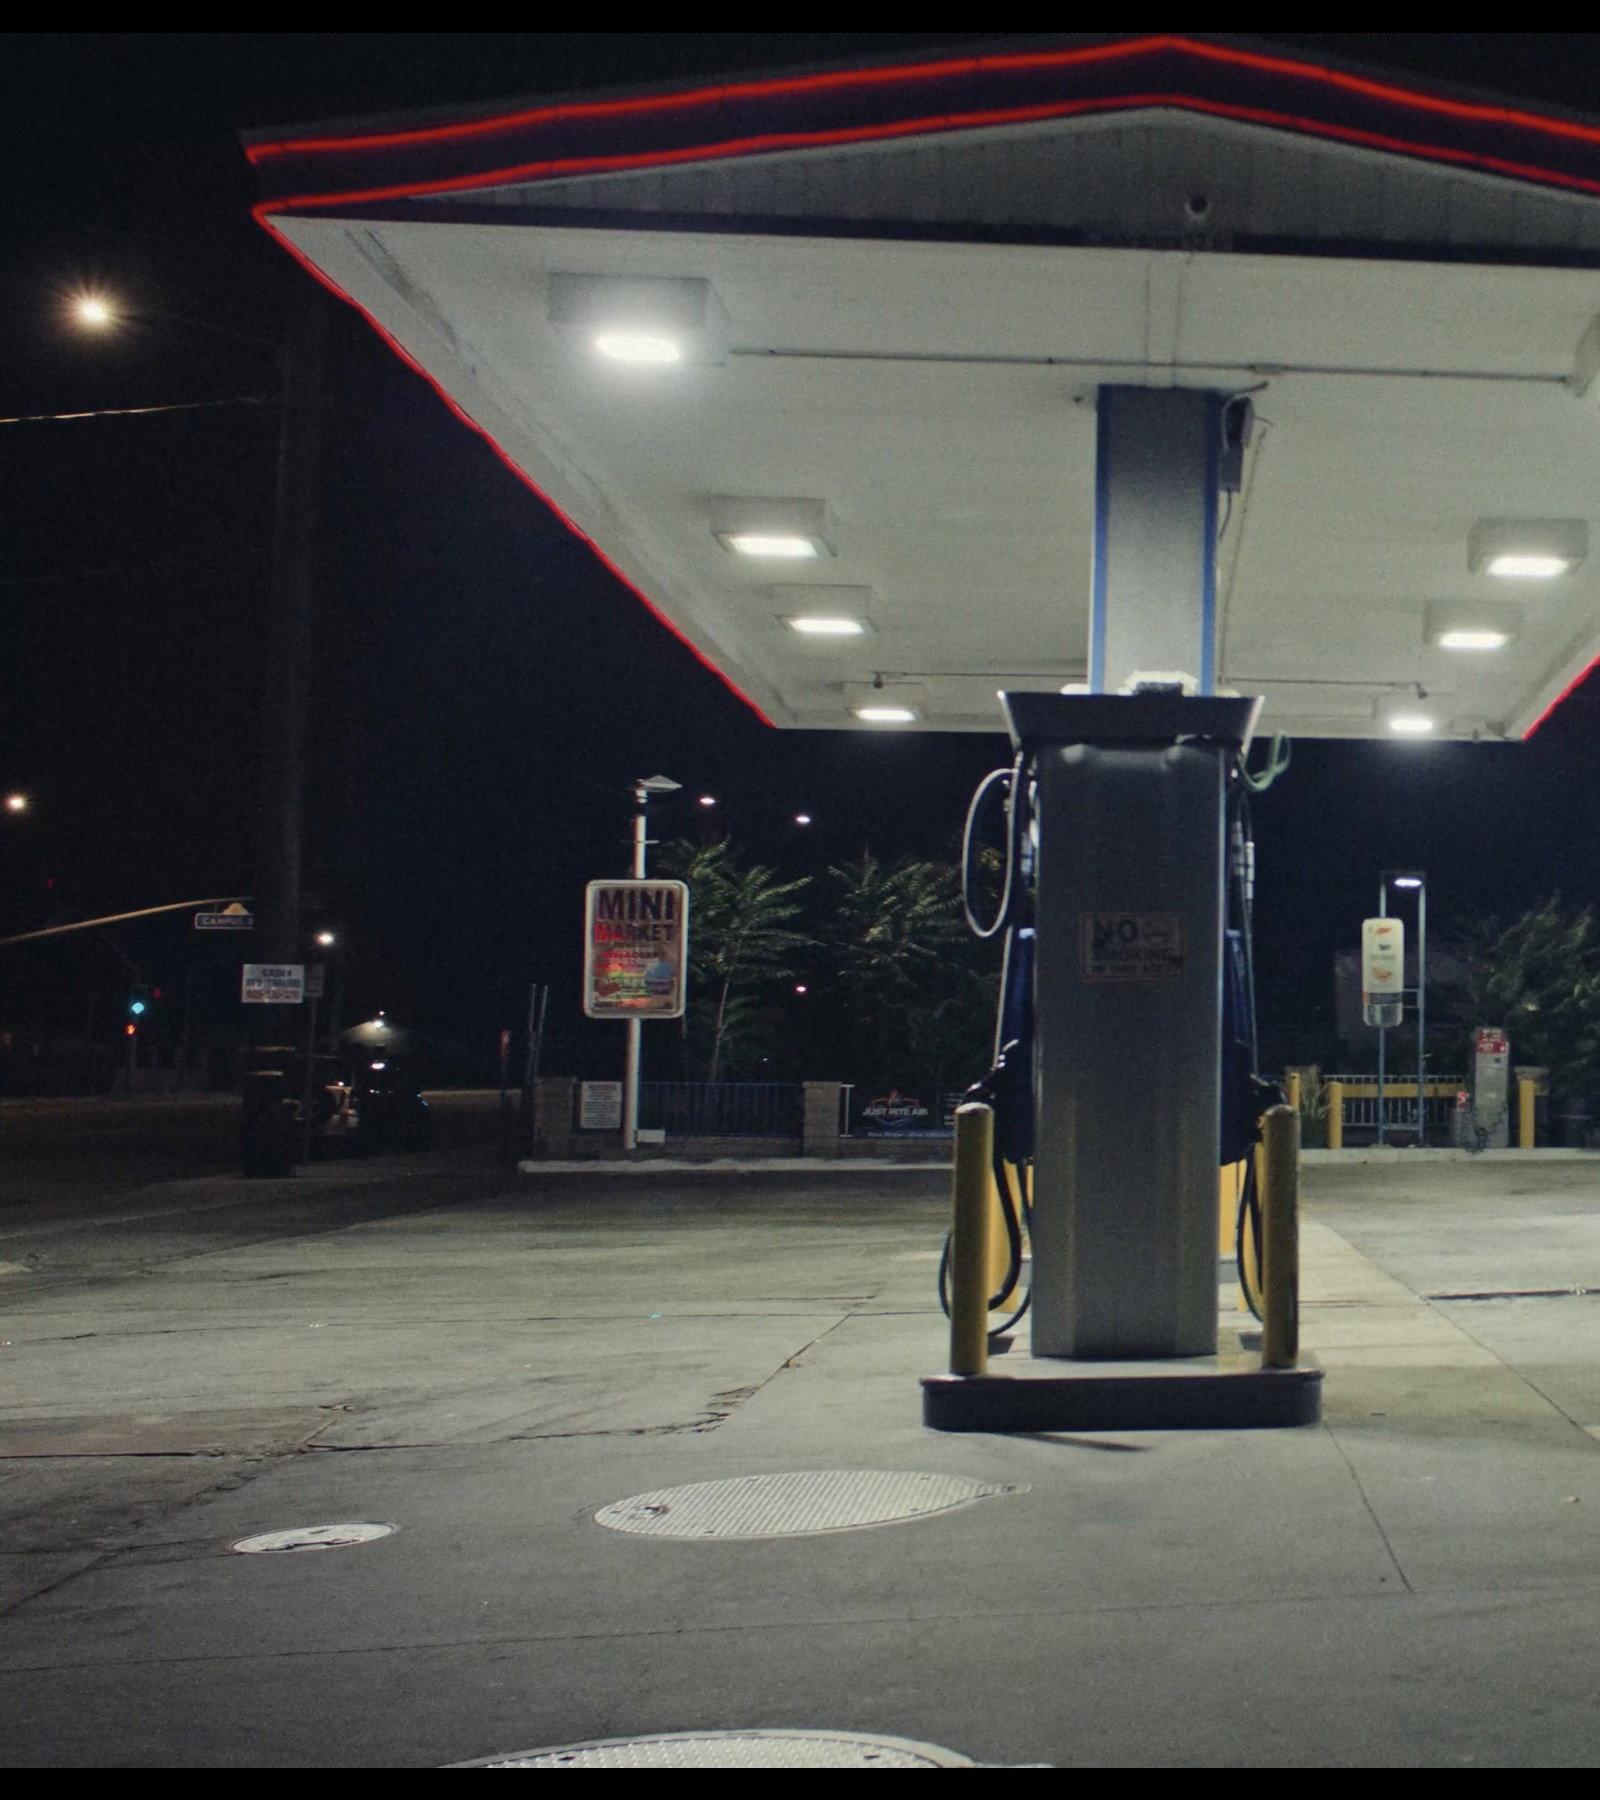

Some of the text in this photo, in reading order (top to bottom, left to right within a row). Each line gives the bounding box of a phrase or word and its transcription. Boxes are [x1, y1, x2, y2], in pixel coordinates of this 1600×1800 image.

[598, 889, 674, 920] MINI
[594, 923, 674, 941] MARKET
[1094, 919, 1138, 944] NO
[862, 1107, 928, 1116] JUST RITE AIR
